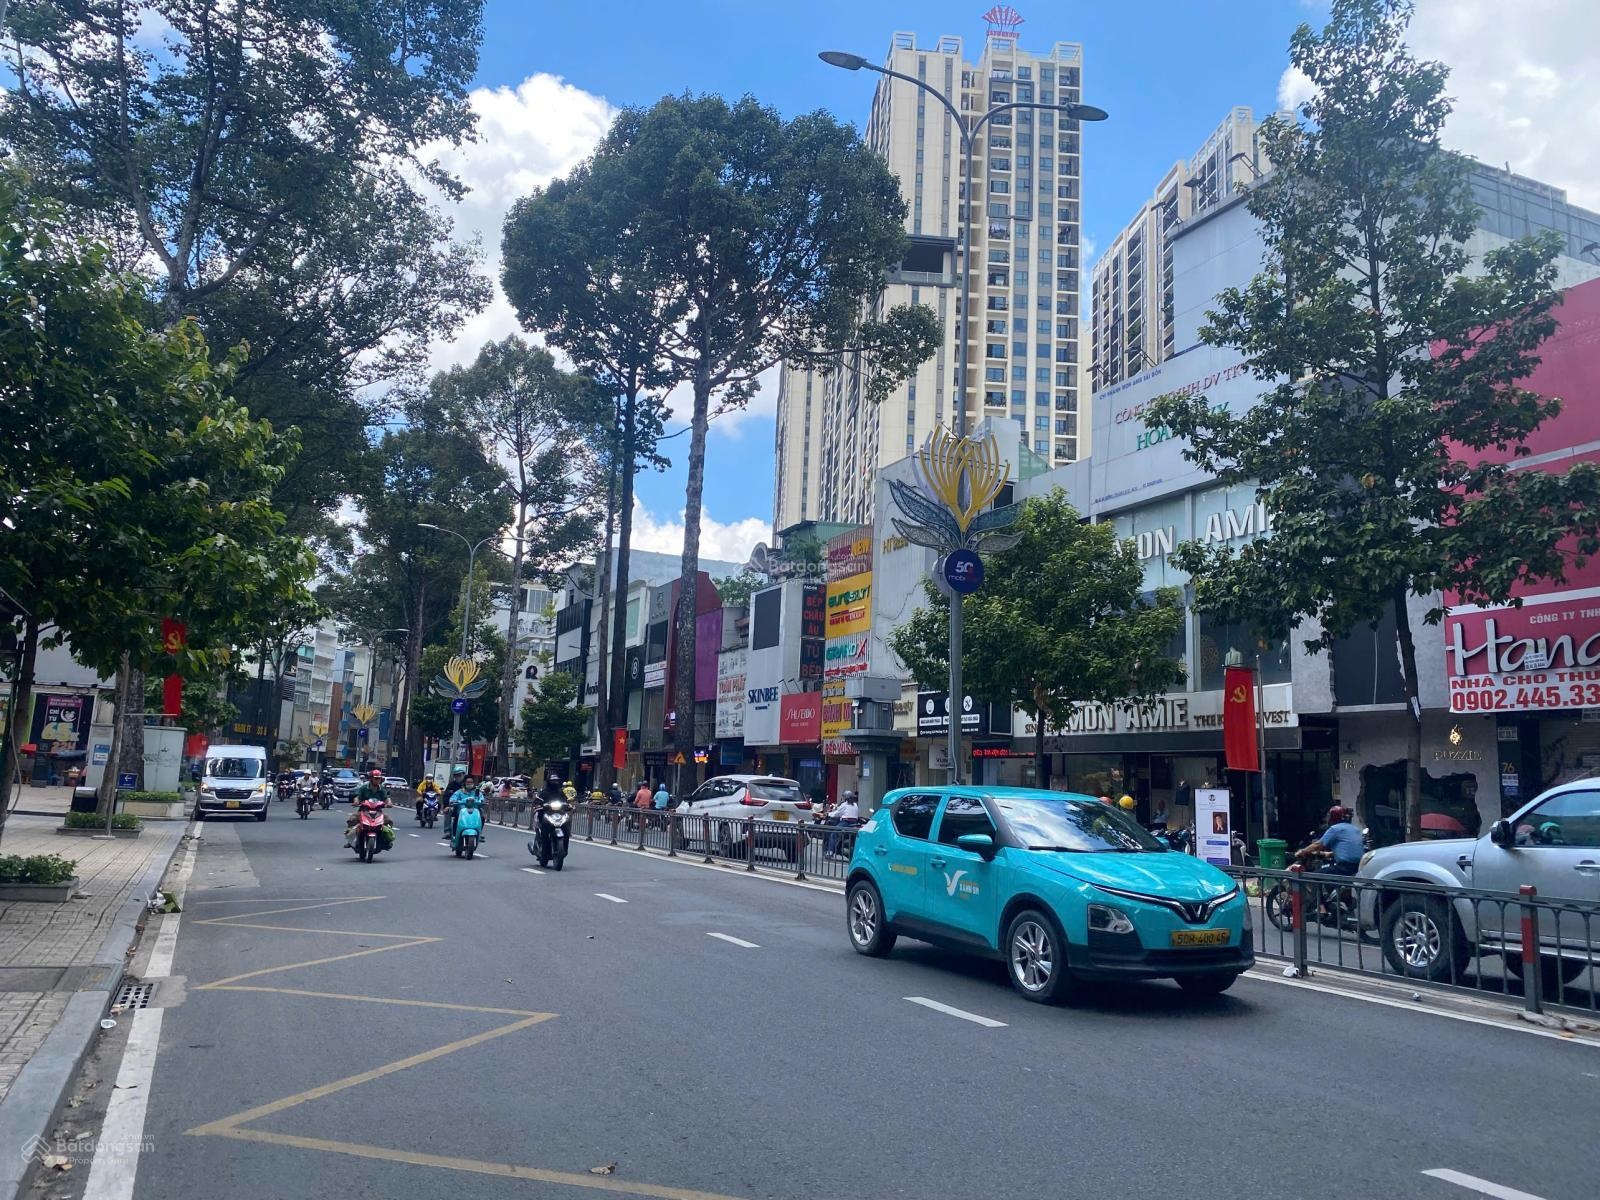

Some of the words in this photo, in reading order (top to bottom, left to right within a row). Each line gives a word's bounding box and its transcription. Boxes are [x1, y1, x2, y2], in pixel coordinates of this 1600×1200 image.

[1113, 525, 1175, 560] ON
[1204, 500, 1276, 546] AMI
[1530, 612, 1559, 624] CÔNG
[1562, 610, 1576, 620] TY
[1452, 676, 1495, 689] NHÀ
[1502, 673, 1548, 685] CHO
[748, 686, 779, 704] SKINBEE
[1126, 698, 1188, 729] AMIE
[1263, 711, 1291, 724] VEST
[1502, 762, 1516, 774] 76
